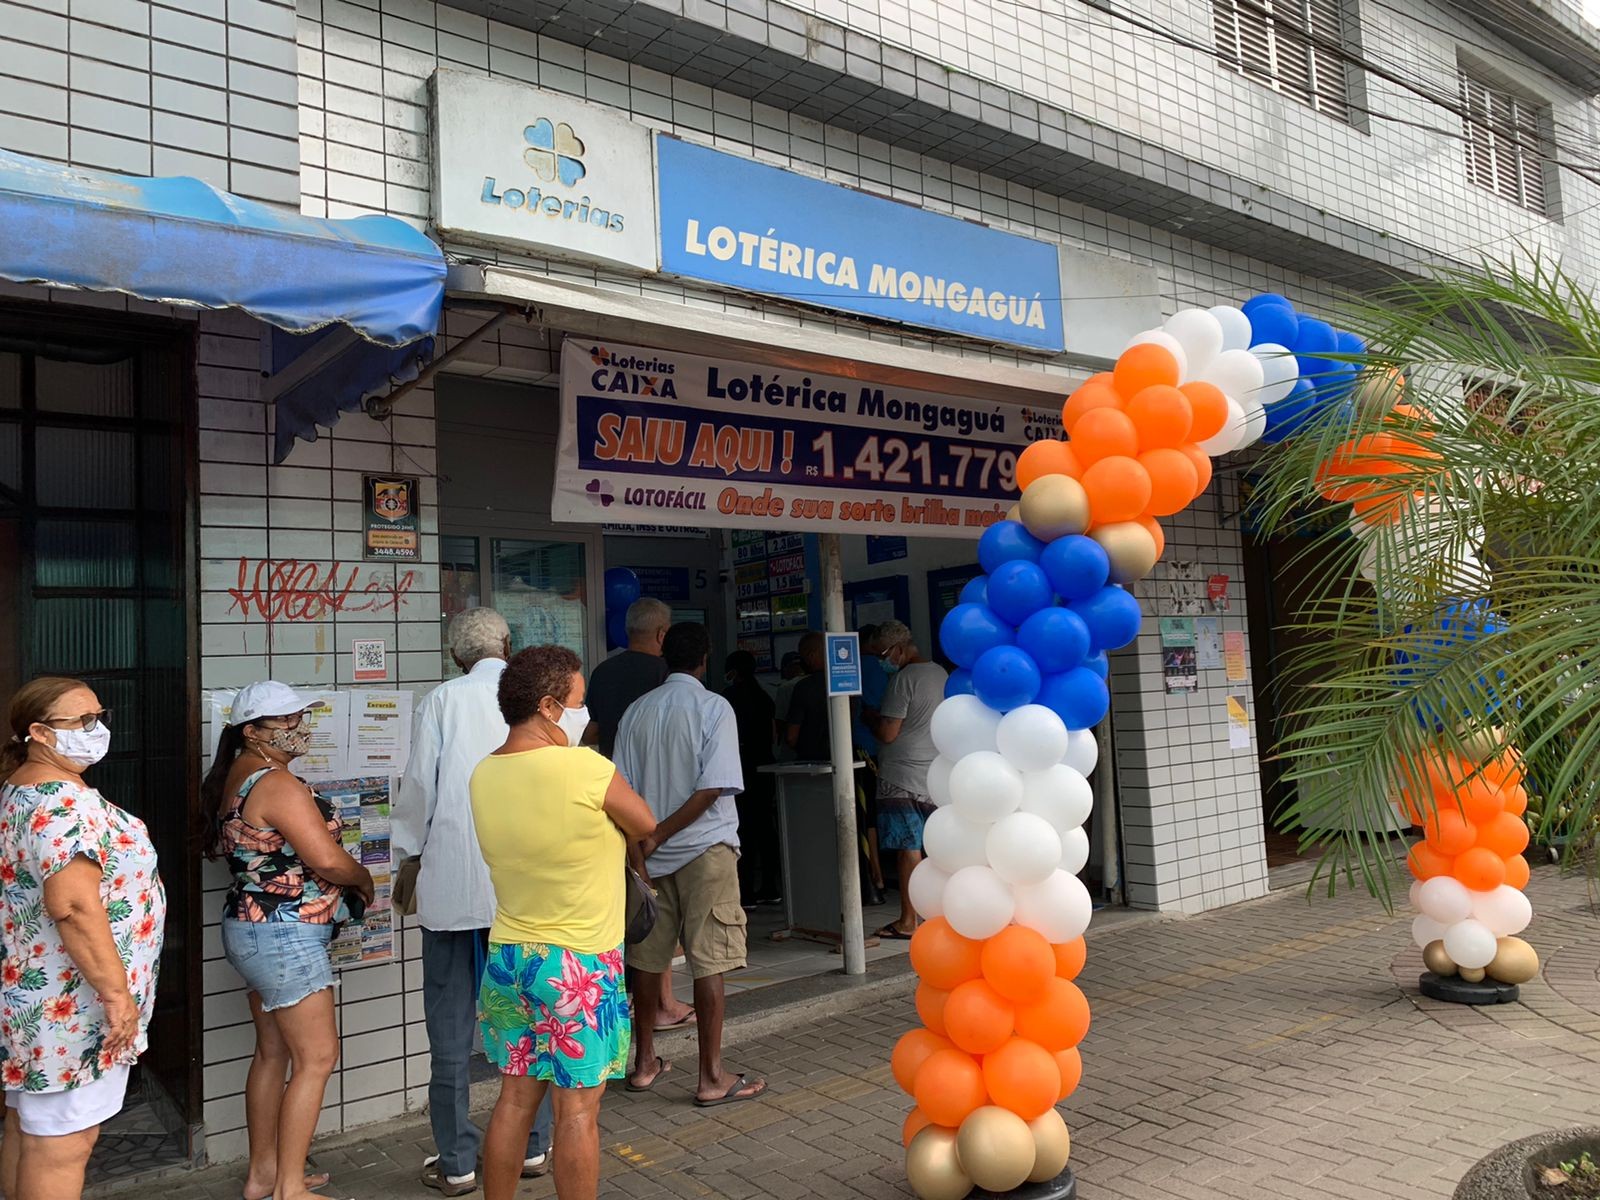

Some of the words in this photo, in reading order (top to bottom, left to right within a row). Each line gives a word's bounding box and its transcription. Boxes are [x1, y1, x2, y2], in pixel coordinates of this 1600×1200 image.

[481, 176, 624, 232] Loterias
[685, 219, 859, 290] LOTÉRICA
[868, 263, 1045, 330] MONGAGUÁ
[610, 352, 675, 375] Loterias
[591, 368, 678, 400] CAIXA
[707, 367, 846, 413] Lotérica
[857, 387, 1005, 435] Mongaguá
[594, 413, 687, 466] SAIU
[688, 423, 774, 476] AQUI
[806, 465, 818, 477] R$
[624, 486, 706, 510] LOTOFÁCIL
[717, 487, 785, 518] Onde
[790, 498, 833, 520] sua
[839, 498, 896, 523] sorte
[902, 497, 961, 527] brilha
[695, 569, 708, 589] 5
